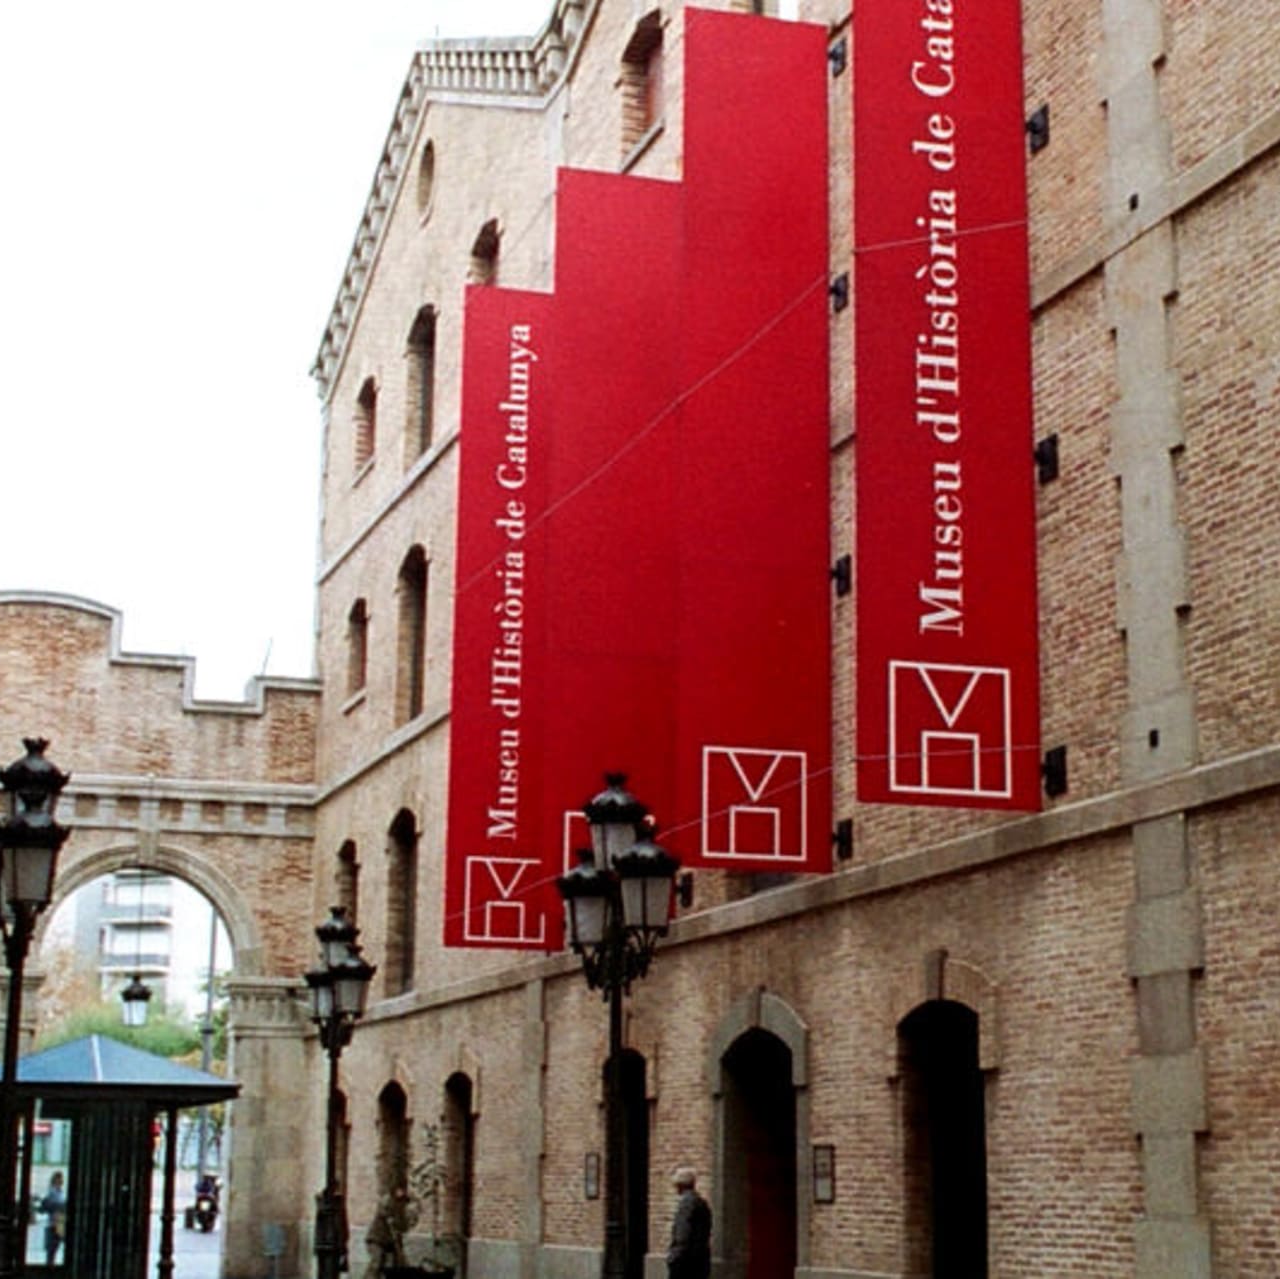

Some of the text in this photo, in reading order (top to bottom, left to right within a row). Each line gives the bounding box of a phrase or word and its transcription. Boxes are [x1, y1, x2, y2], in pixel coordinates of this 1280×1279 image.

[910, 112, 957, 172] de
[915, 188, 962, 444] d'Història
[486, 322, 539, 840] Museu d'Història de Catalunya
[918, 461, 964, 637] Museu
